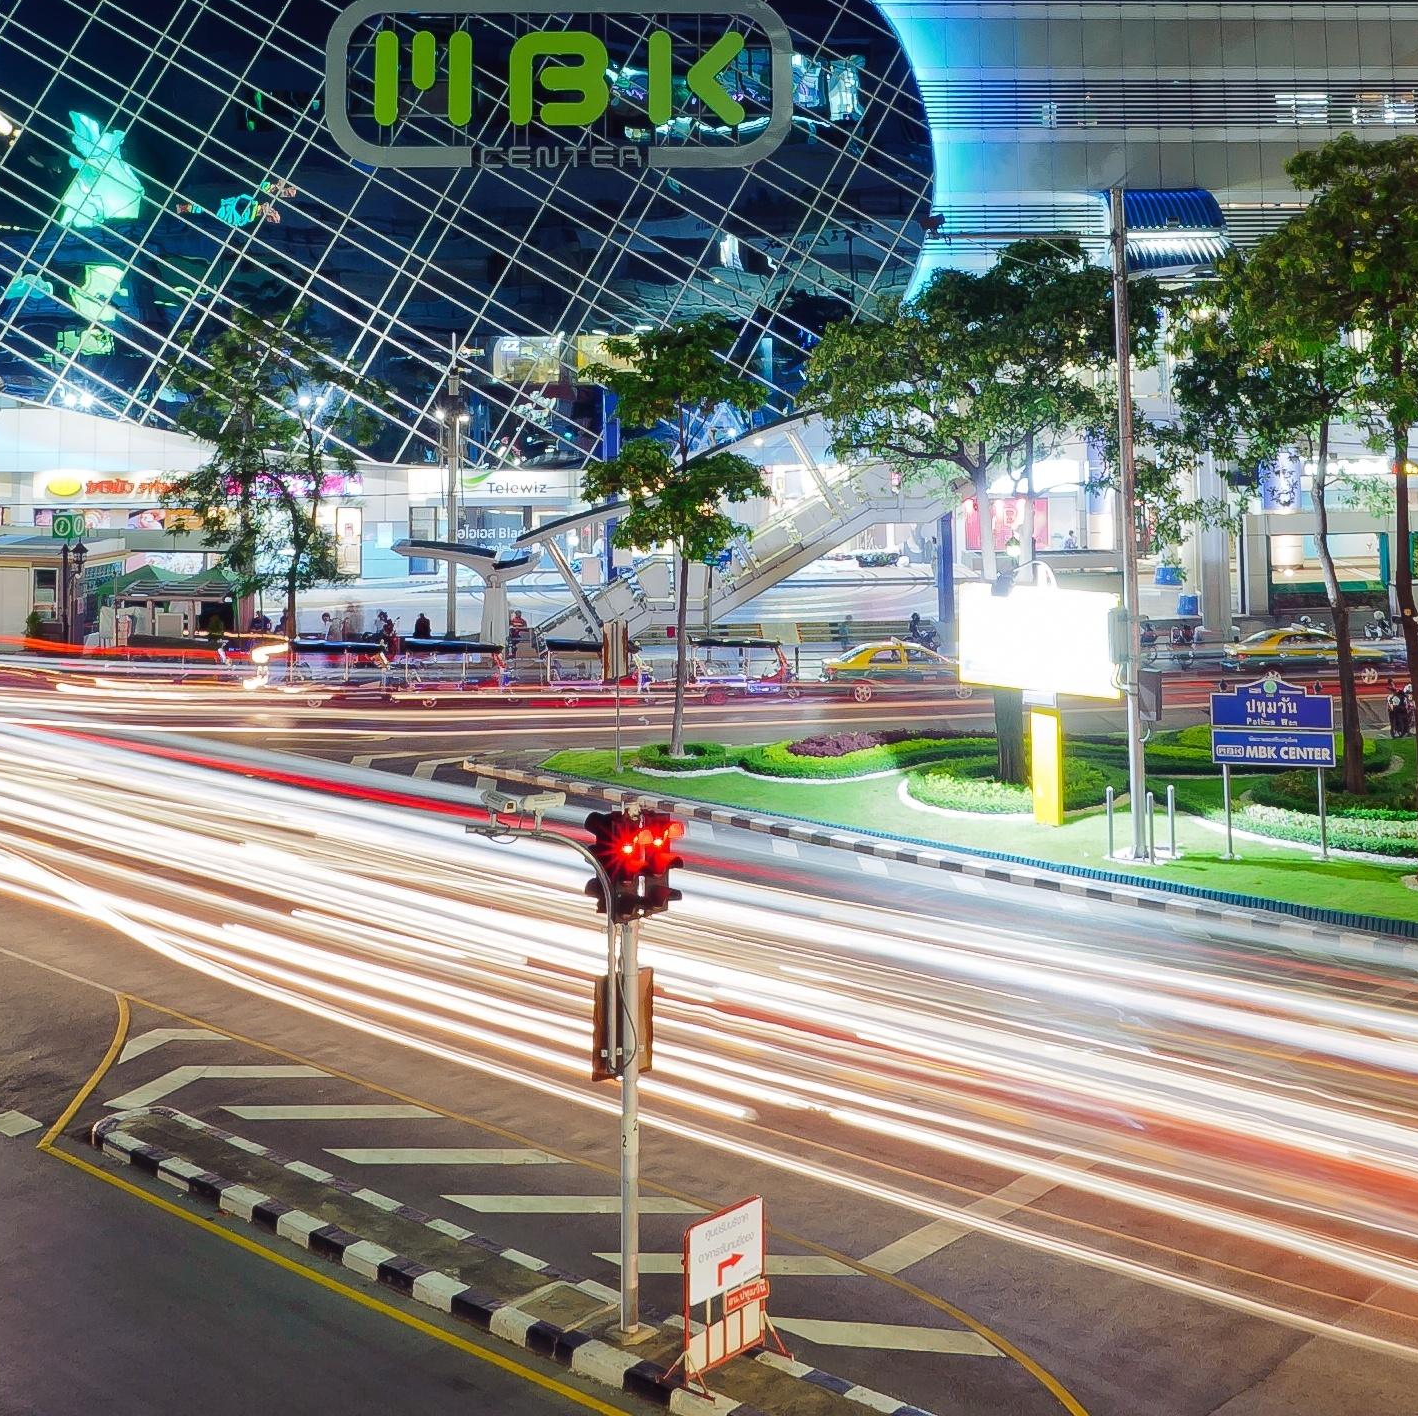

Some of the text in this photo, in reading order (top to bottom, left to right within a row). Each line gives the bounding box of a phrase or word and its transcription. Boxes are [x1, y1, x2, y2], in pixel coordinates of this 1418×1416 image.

[374, 30, 745, 126] MBK
[481, 146, 642, 169] CENTER
[487, 482, 548, 494] Telewiz
[457, 524, 496, 539] อไอเอส
[1246, 697, 1298, 718] ปทุมวัน
[1246, 746, 1278, 759] MBK
[1280, 747, 1332, 761] CENTER
[622, 1134, 628, 1149] 2
